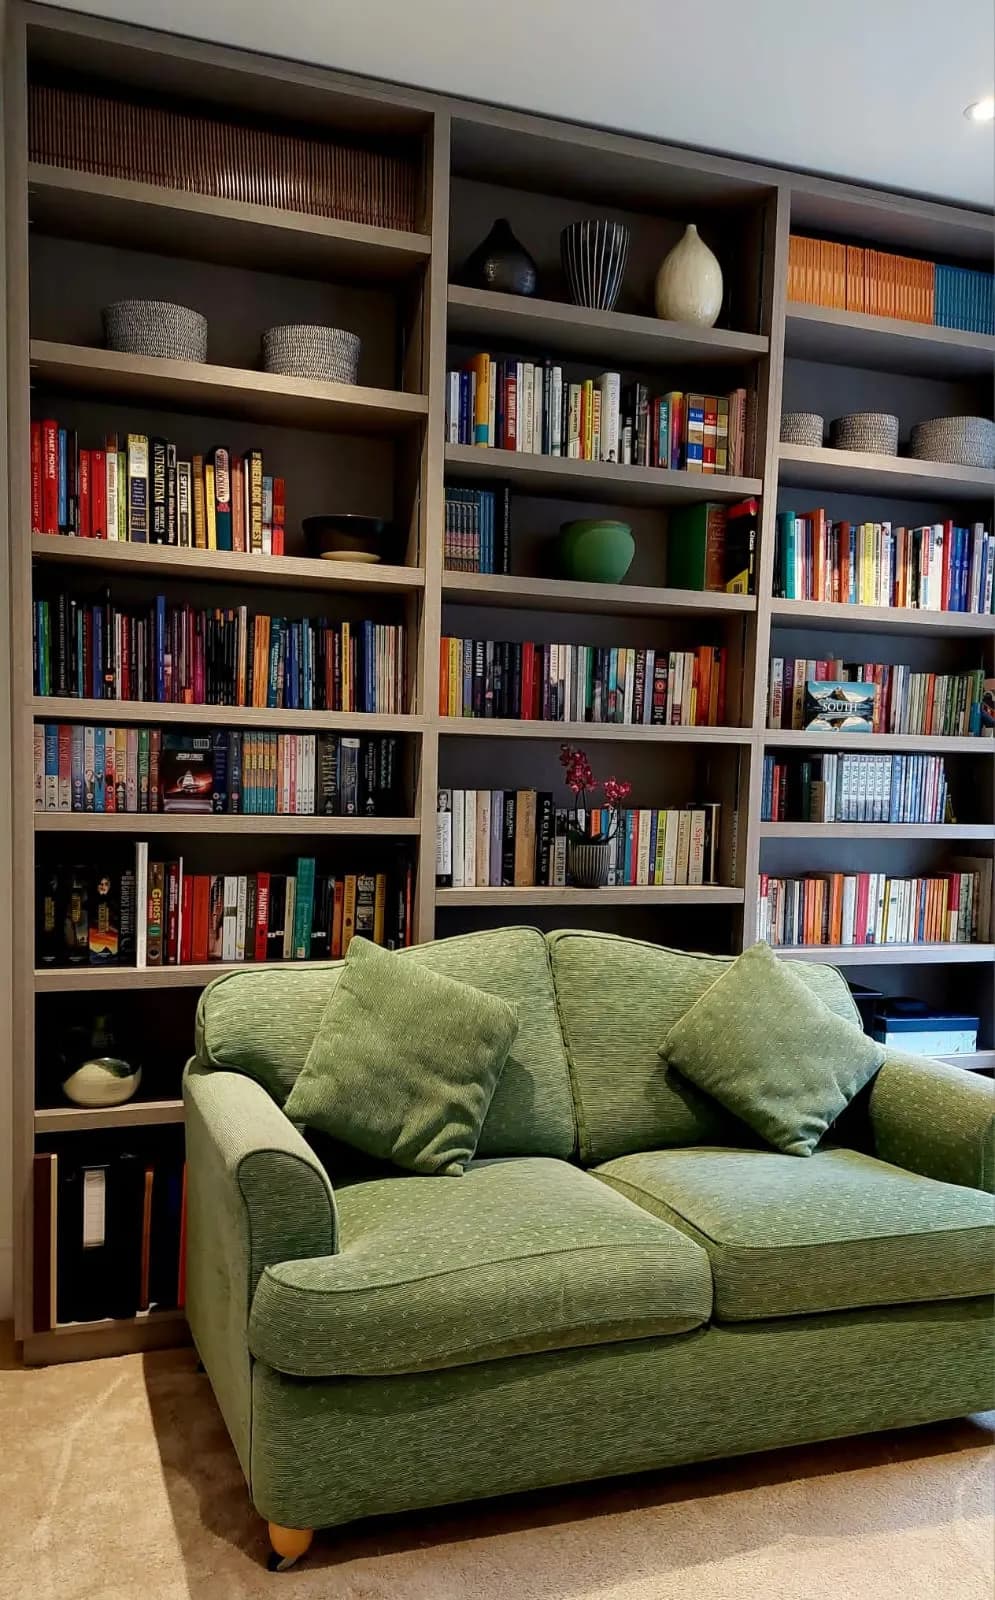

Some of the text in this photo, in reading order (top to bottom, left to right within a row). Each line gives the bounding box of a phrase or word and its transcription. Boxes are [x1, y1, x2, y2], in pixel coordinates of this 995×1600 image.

[48, 429, 56, 480] SMART MONEY
[154, 443, 165, 503] ANTISEMITISM
[180, 475, 189, 512] SPITFIRE
[251, 459, 262, 540] SHERLOCK HOLMES
[823, 703, 857, 712] SOUTH
[541, 800, 551, 872] CAROLE KING
[692, 827, 704, 864] Sapiens
[556, 840, 565, 876] CLAPTON
[152, 889, 162, 924] GHOST
[258, 888, 268, 925] PHANTOMS
